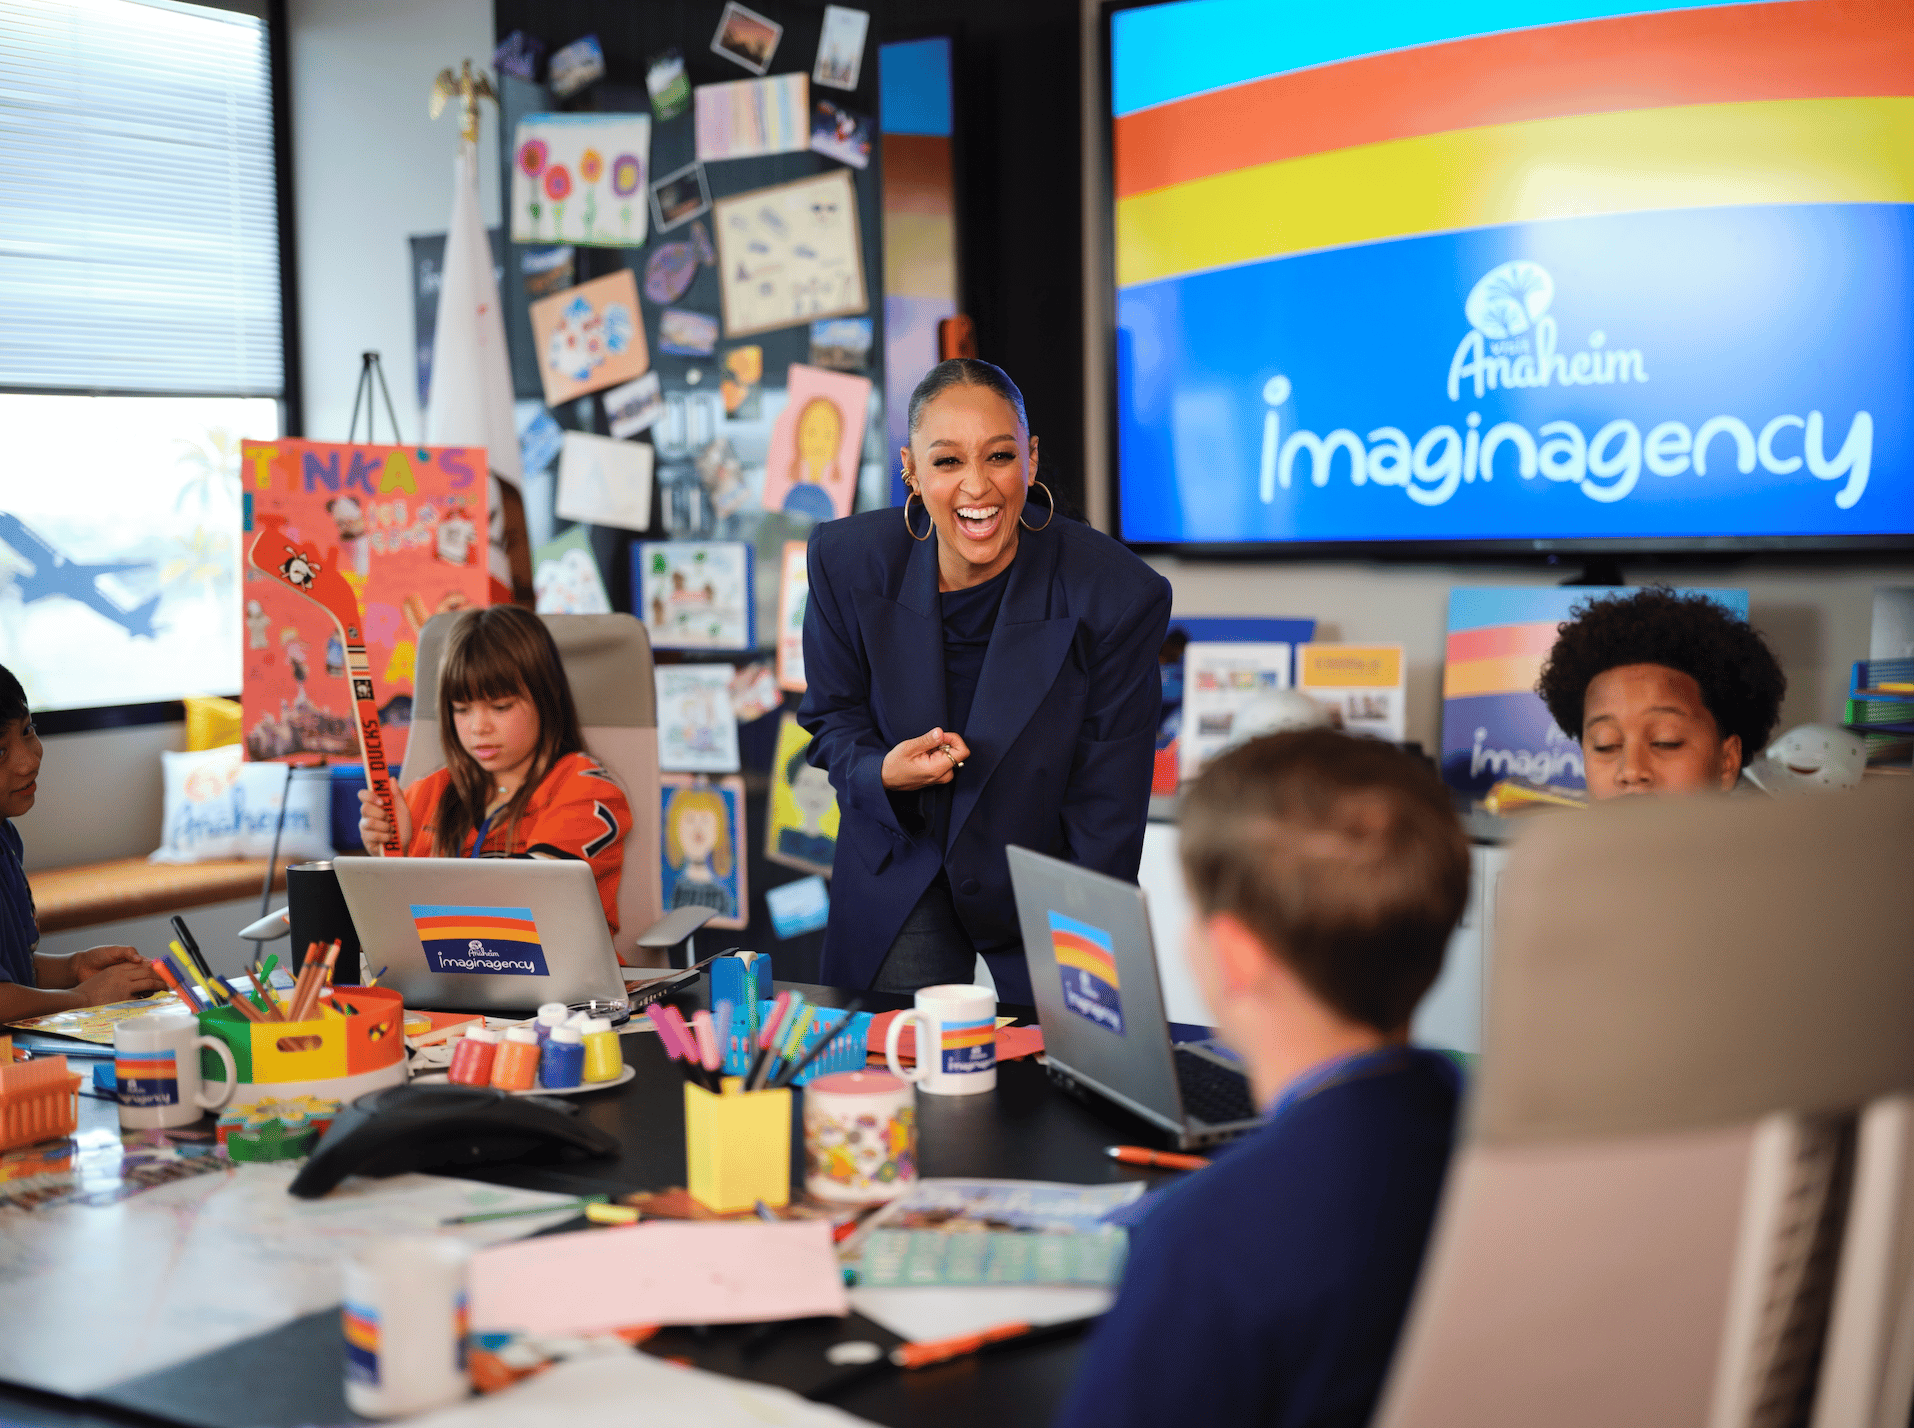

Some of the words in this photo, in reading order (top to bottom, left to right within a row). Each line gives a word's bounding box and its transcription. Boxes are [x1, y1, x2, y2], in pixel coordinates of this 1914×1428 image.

[1447, 315, 1650, 402] Anaheim
[362, 718, 388, 772] DUCKS
[1470, 726, 1586, 785] imagin
[437, 950, 536, 974] imaginagency
[468, 946, 501, 958] Anaheim
